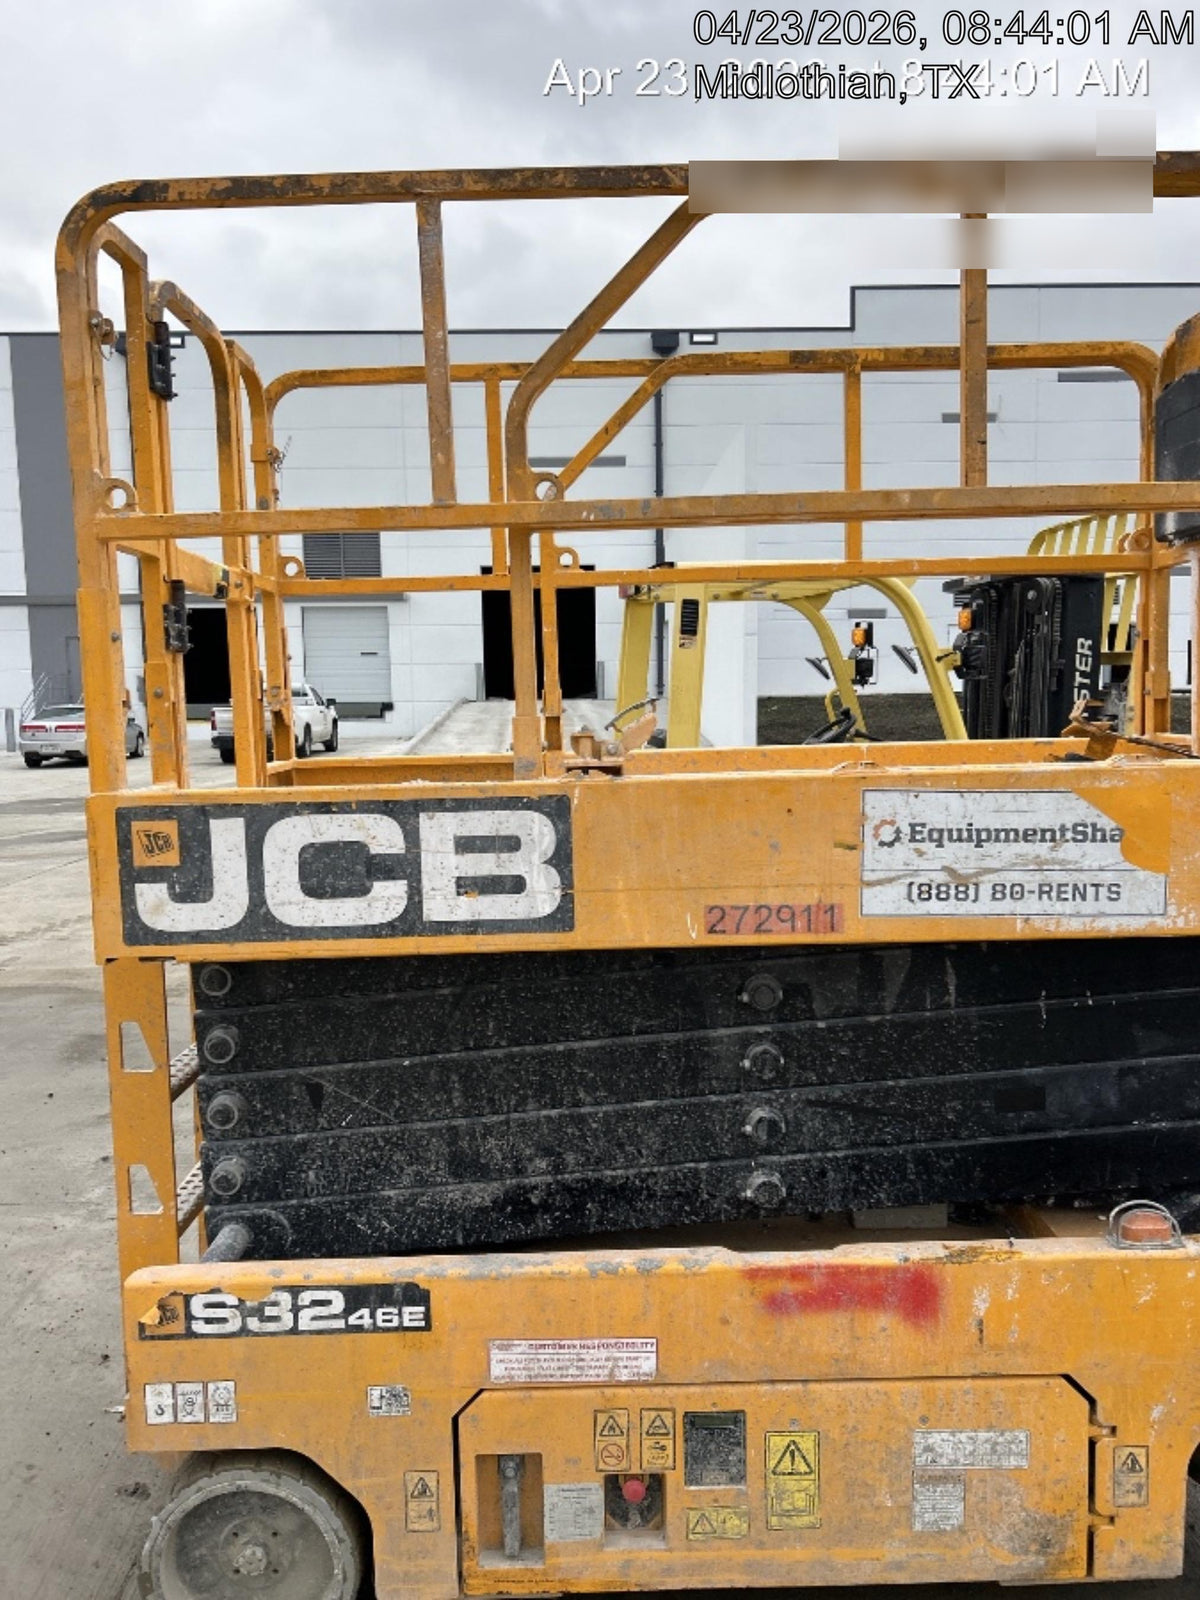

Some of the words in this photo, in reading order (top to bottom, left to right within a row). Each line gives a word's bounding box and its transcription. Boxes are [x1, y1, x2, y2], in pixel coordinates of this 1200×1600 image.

[1073, 637, 1093, 704] STER
[141, 830, 175, 857] JCB
[908, 823, 1124, 848] EquipmentSha
[134, 810, 562, 932] JCB
[990, 882, 1122, 903] 80-RENTS
[707, 904, 839, 935] 272911
